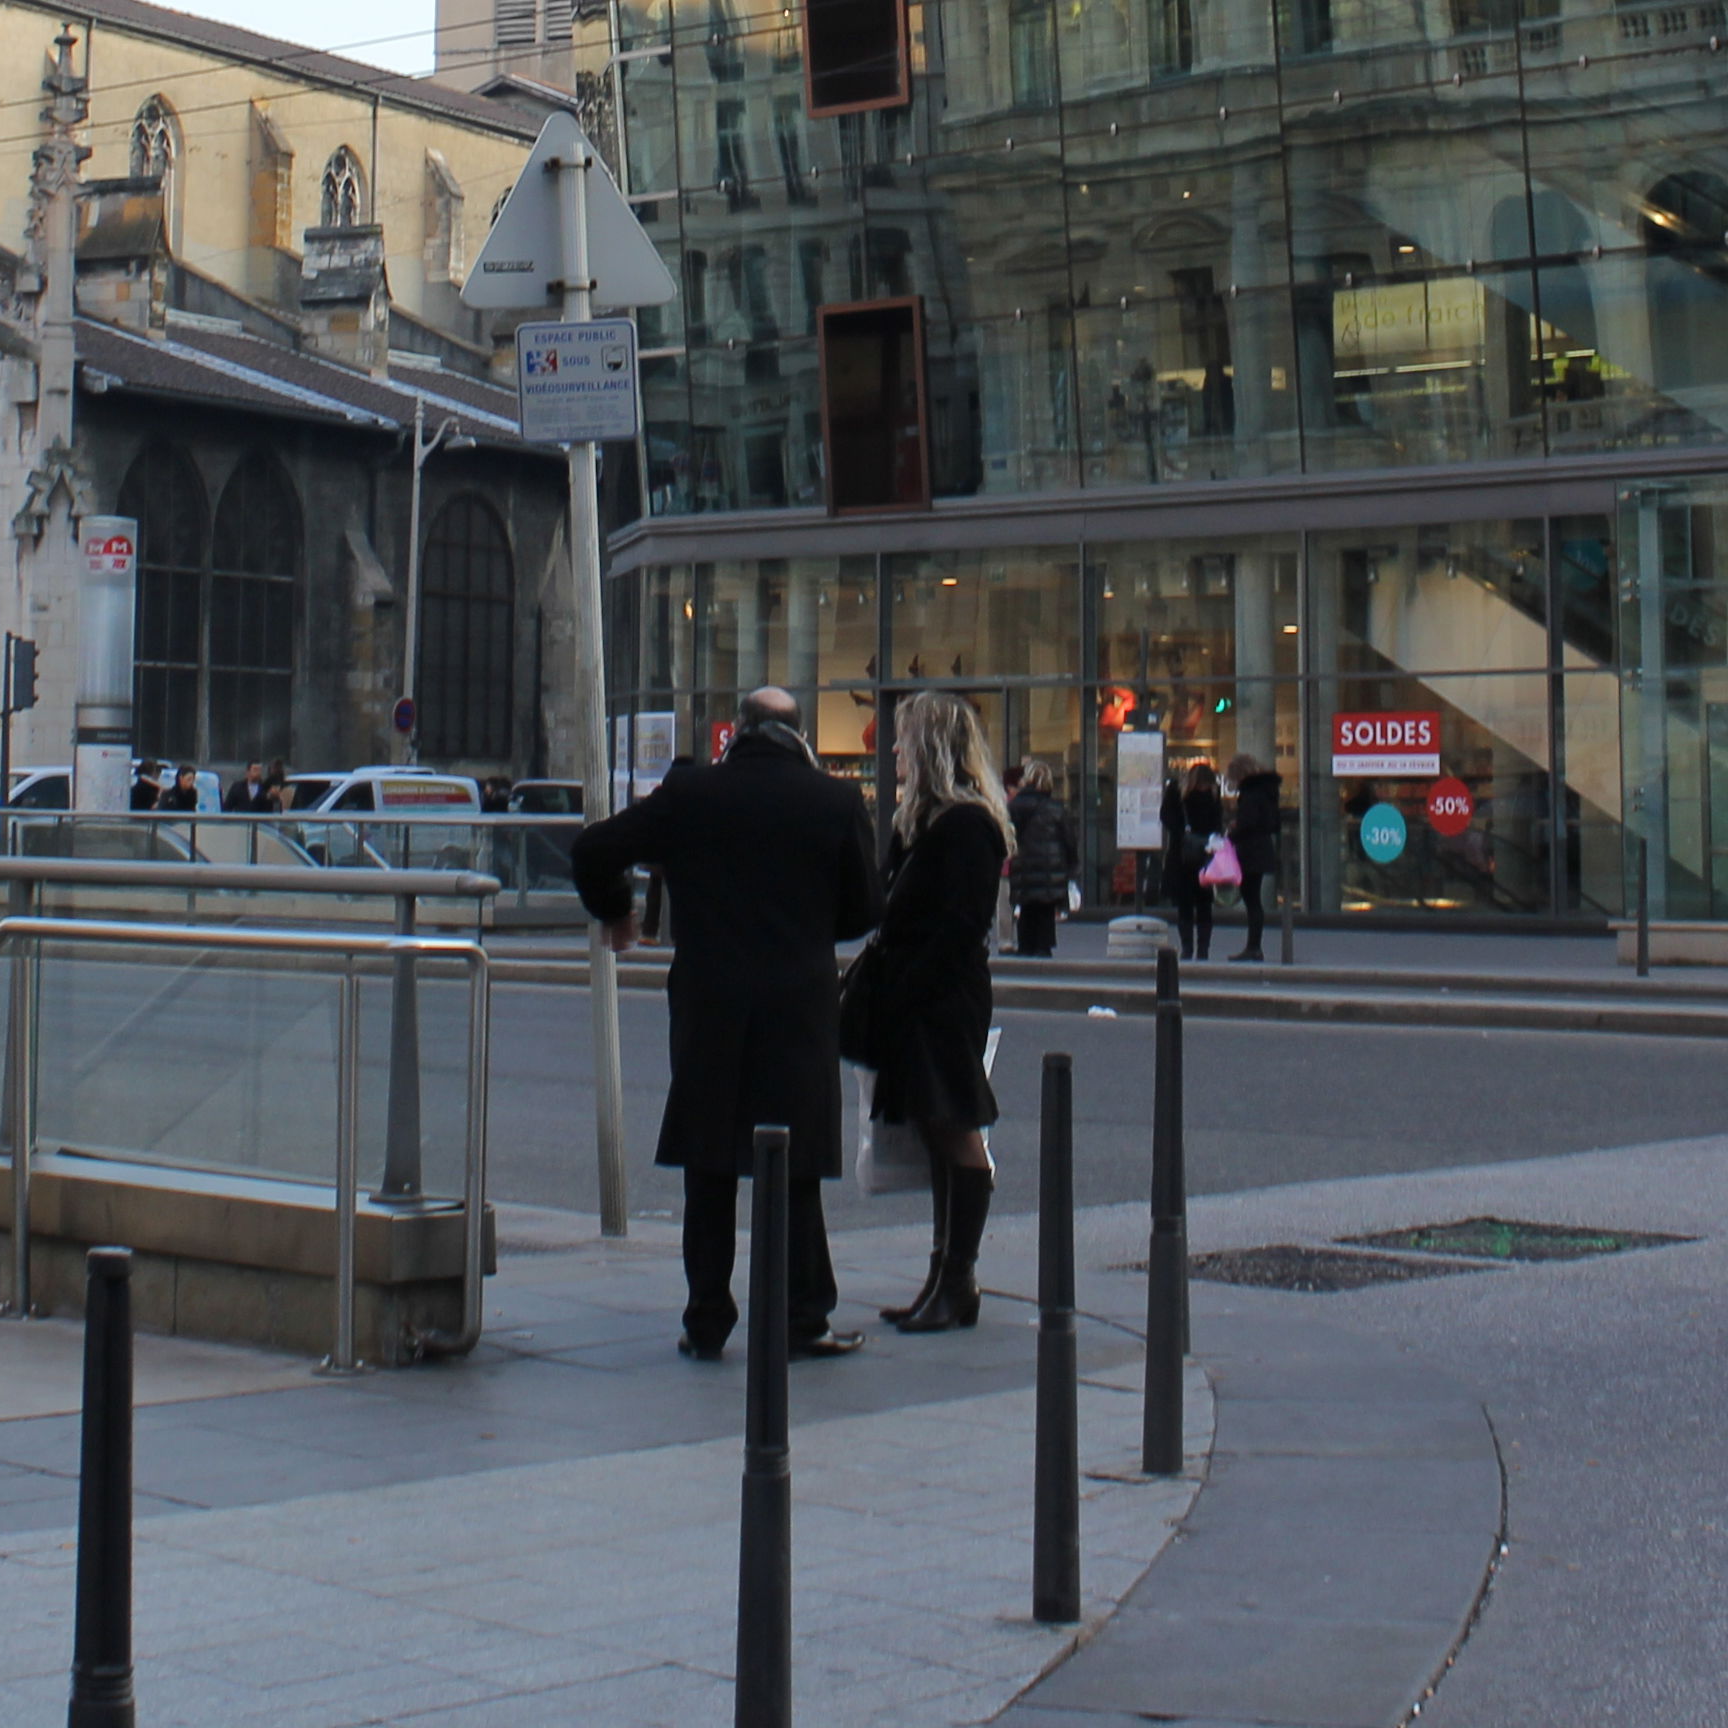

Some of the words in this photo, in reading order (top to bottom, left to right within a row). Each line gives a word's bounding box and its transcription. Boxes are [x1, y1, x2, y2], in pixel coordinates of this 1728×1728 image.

[535, 332, 572, 344] ESPACE
[578, 329, 617, 341] PUBLIC
[562, 356, 591, 367] SOUS
[1340, 720, 1432, 747] SOLDES
[1430, 797, 1470, 816] -50%
[1366, 827, 1402, 846] -30%
